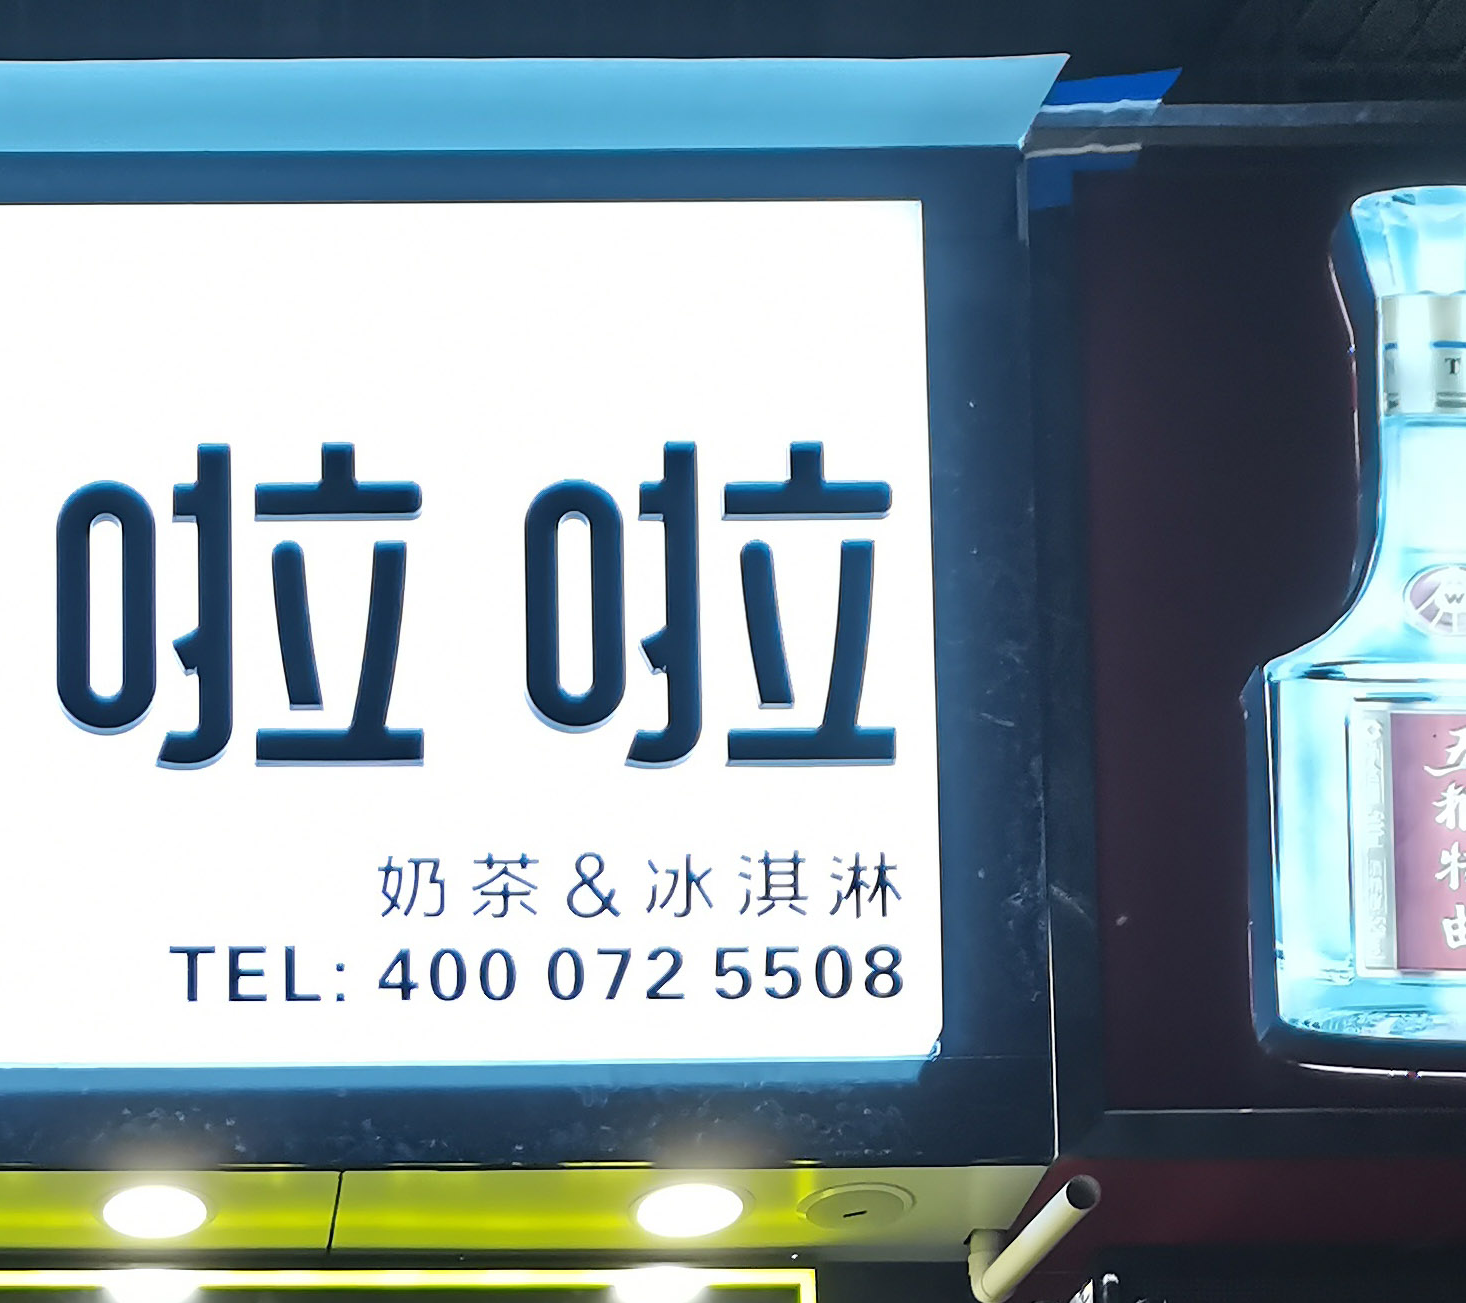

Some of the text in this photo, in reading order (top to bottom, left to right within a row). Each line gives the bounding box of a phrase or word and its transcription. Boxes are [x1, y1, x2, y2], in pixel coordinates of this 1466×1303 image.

[377, 850, 903, 920] 奶茶&冰淇淋
[169, 945, 904, 1002] TEL: 400 072 5508
